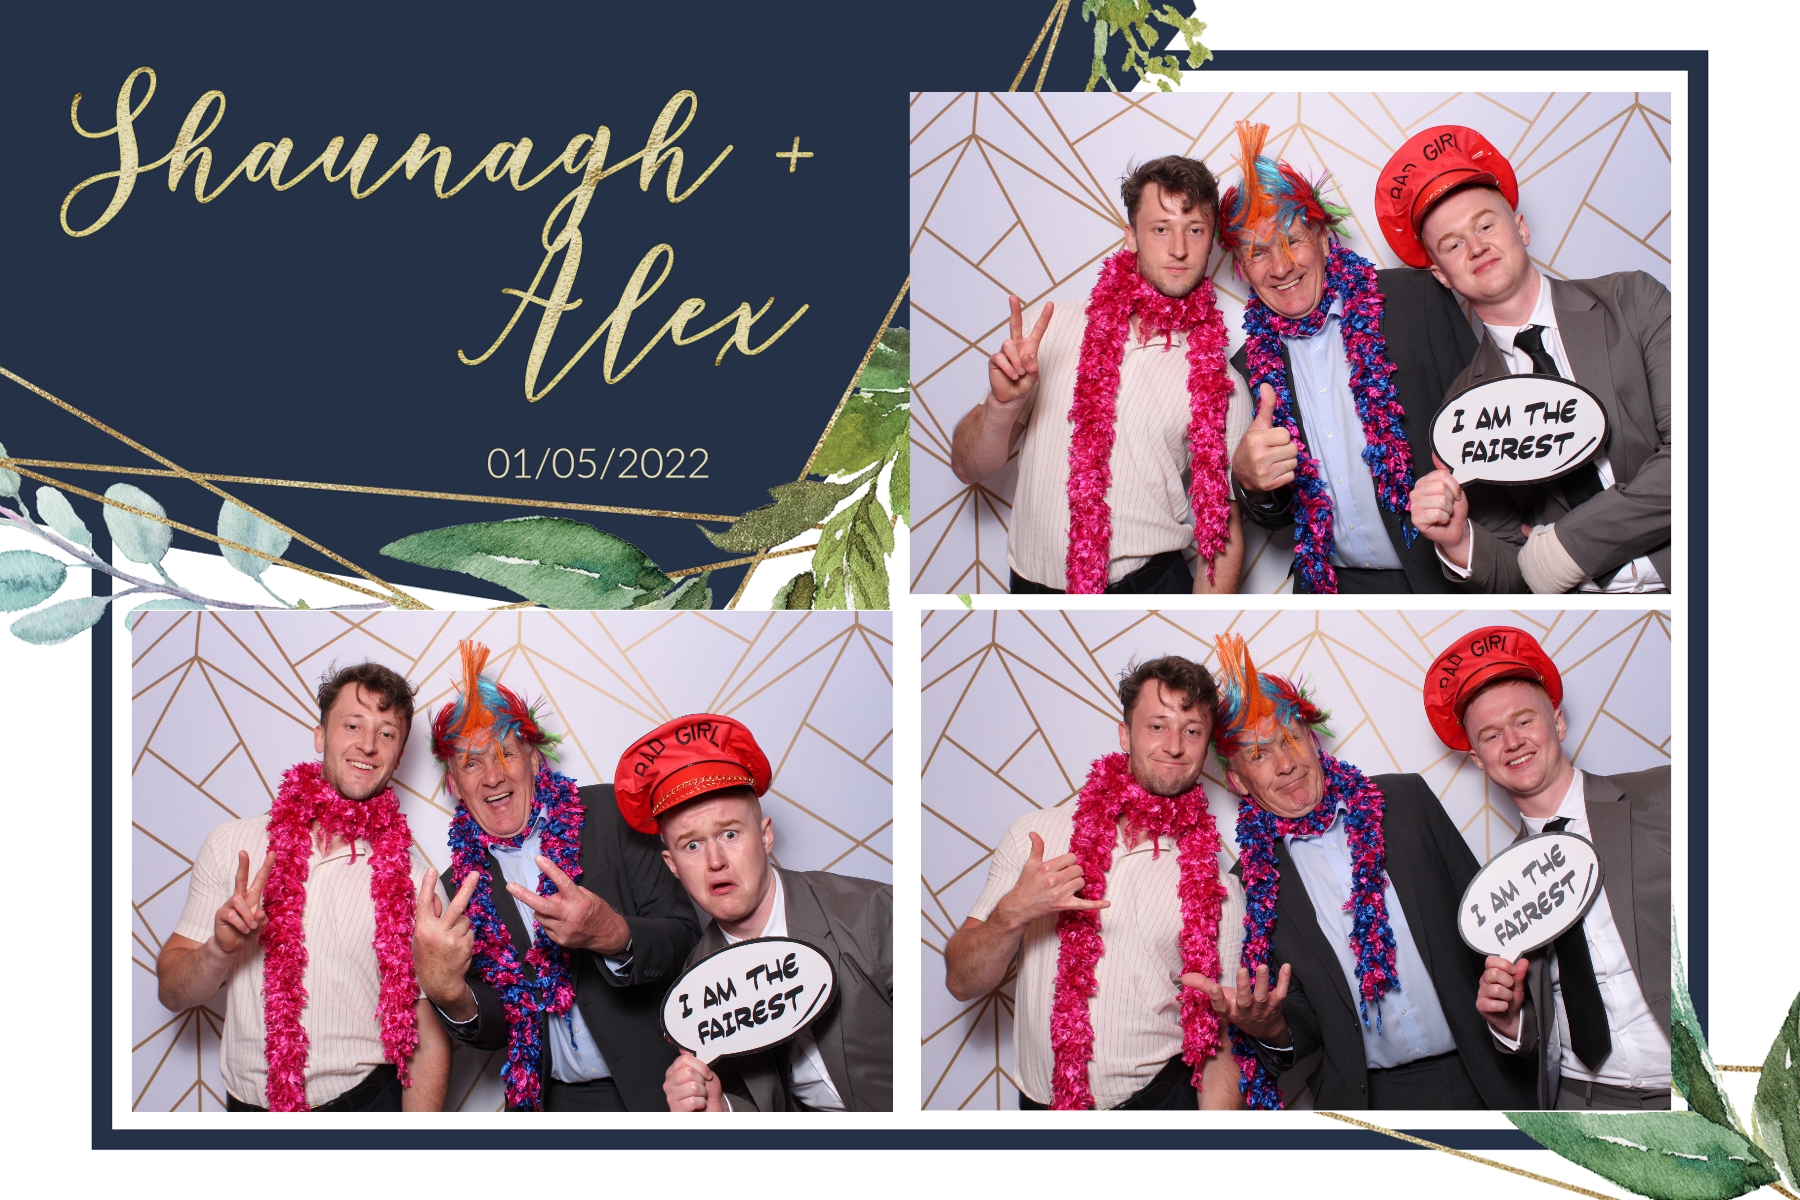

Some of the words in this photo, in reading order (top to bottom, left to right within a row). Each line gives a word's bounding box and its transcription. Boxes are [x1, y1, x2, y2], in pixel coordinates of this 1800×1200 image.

[1423, 133, 1463, 161] GIRL
[1451, 409, 1465, 433] I
[1475, 404, 1511, 430] AM
[1524, 398, 1578, 426] THE
[1461, 431, 1575, 465] FAIREST
[1470, 634, 1510, 657] GIRL
[675, 722, 720, 747] GIRL
[1470, 904, 1486, 928] I
[1490, 879, 1520, 913] AM
[1521, 843, 1566, 885] THE
[1494, 869, 1576, 947] FAIREST
[678, 993, 693, 1019] I
[703, 977, 737, 1009] AM
[746, 952, 799, 991] THE
[697, 985, 804, 1045] FAIREST
